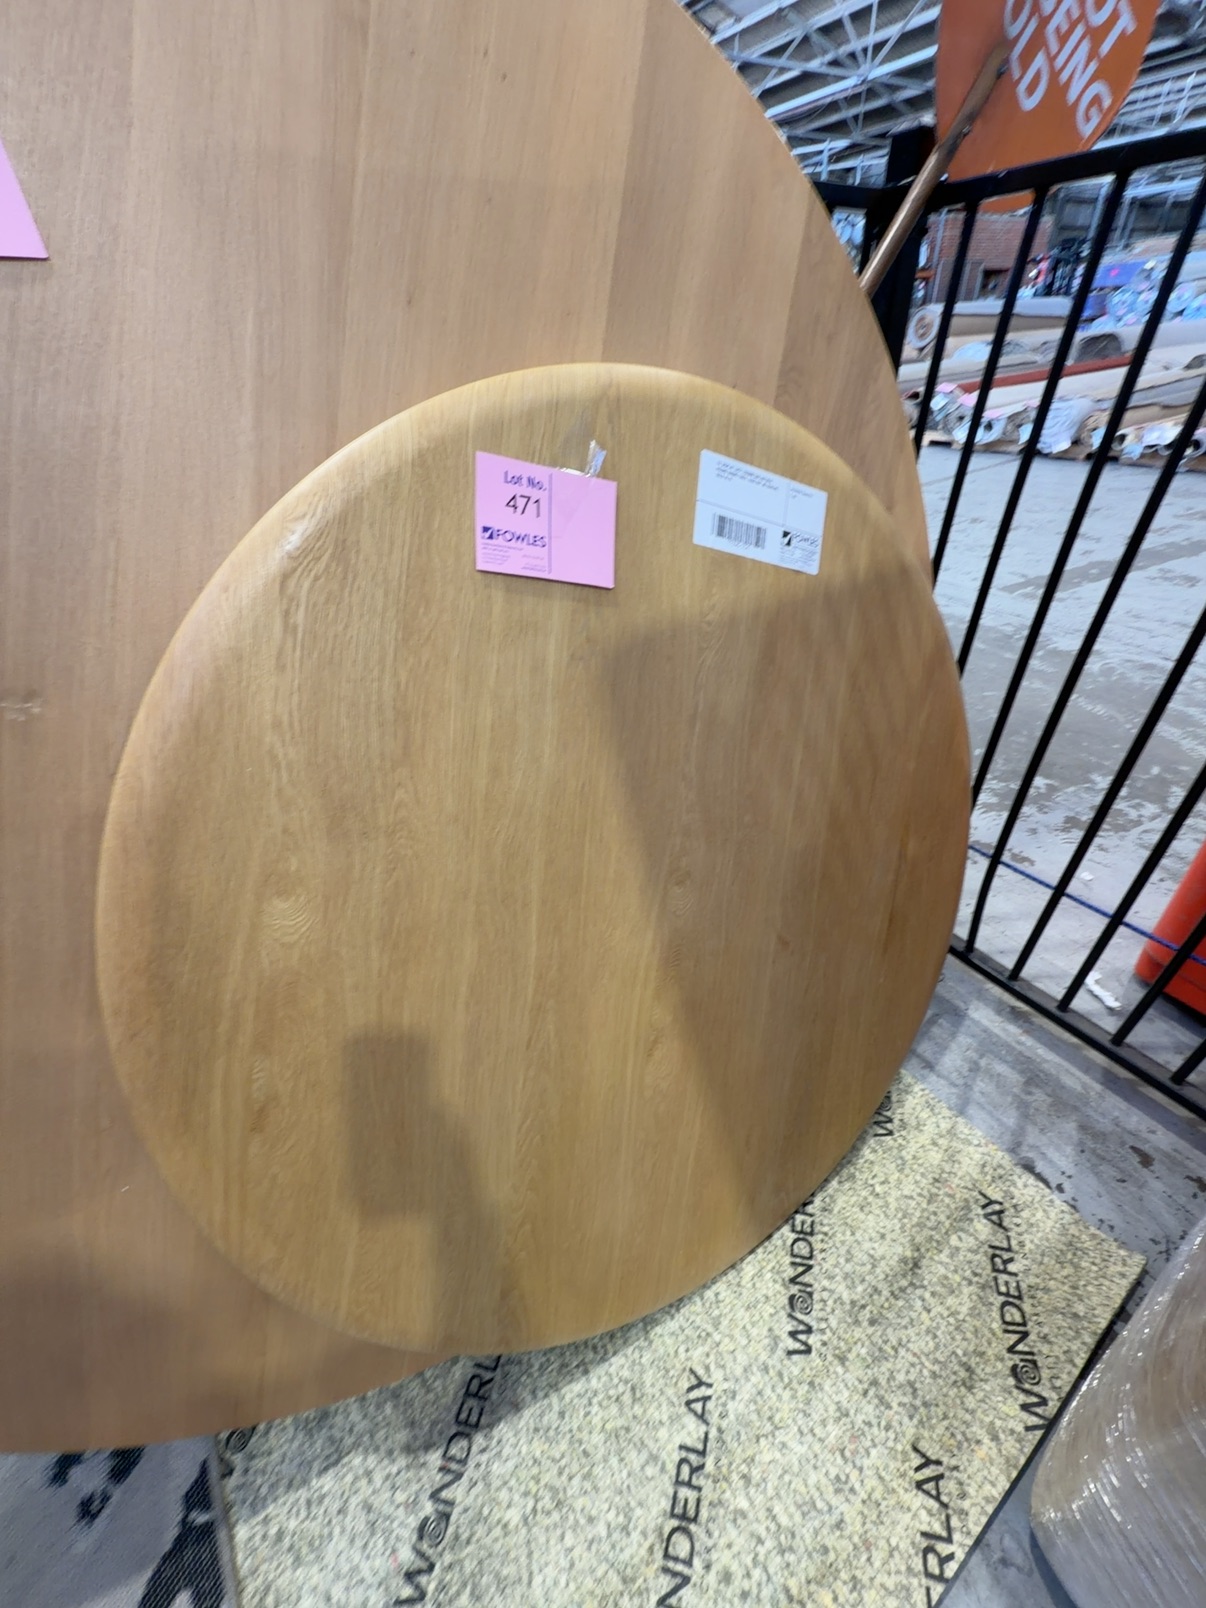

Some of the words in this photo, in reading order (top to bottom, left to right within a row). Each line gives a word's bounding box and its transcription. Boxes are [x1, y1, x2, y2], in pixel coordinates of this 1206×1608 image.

[1040, 0, 1113, 139] EING
[503, 470, 524, 485] Lot
[505, 493, 541, 519] 471
[496, 529, 548, 548] FOWLES
